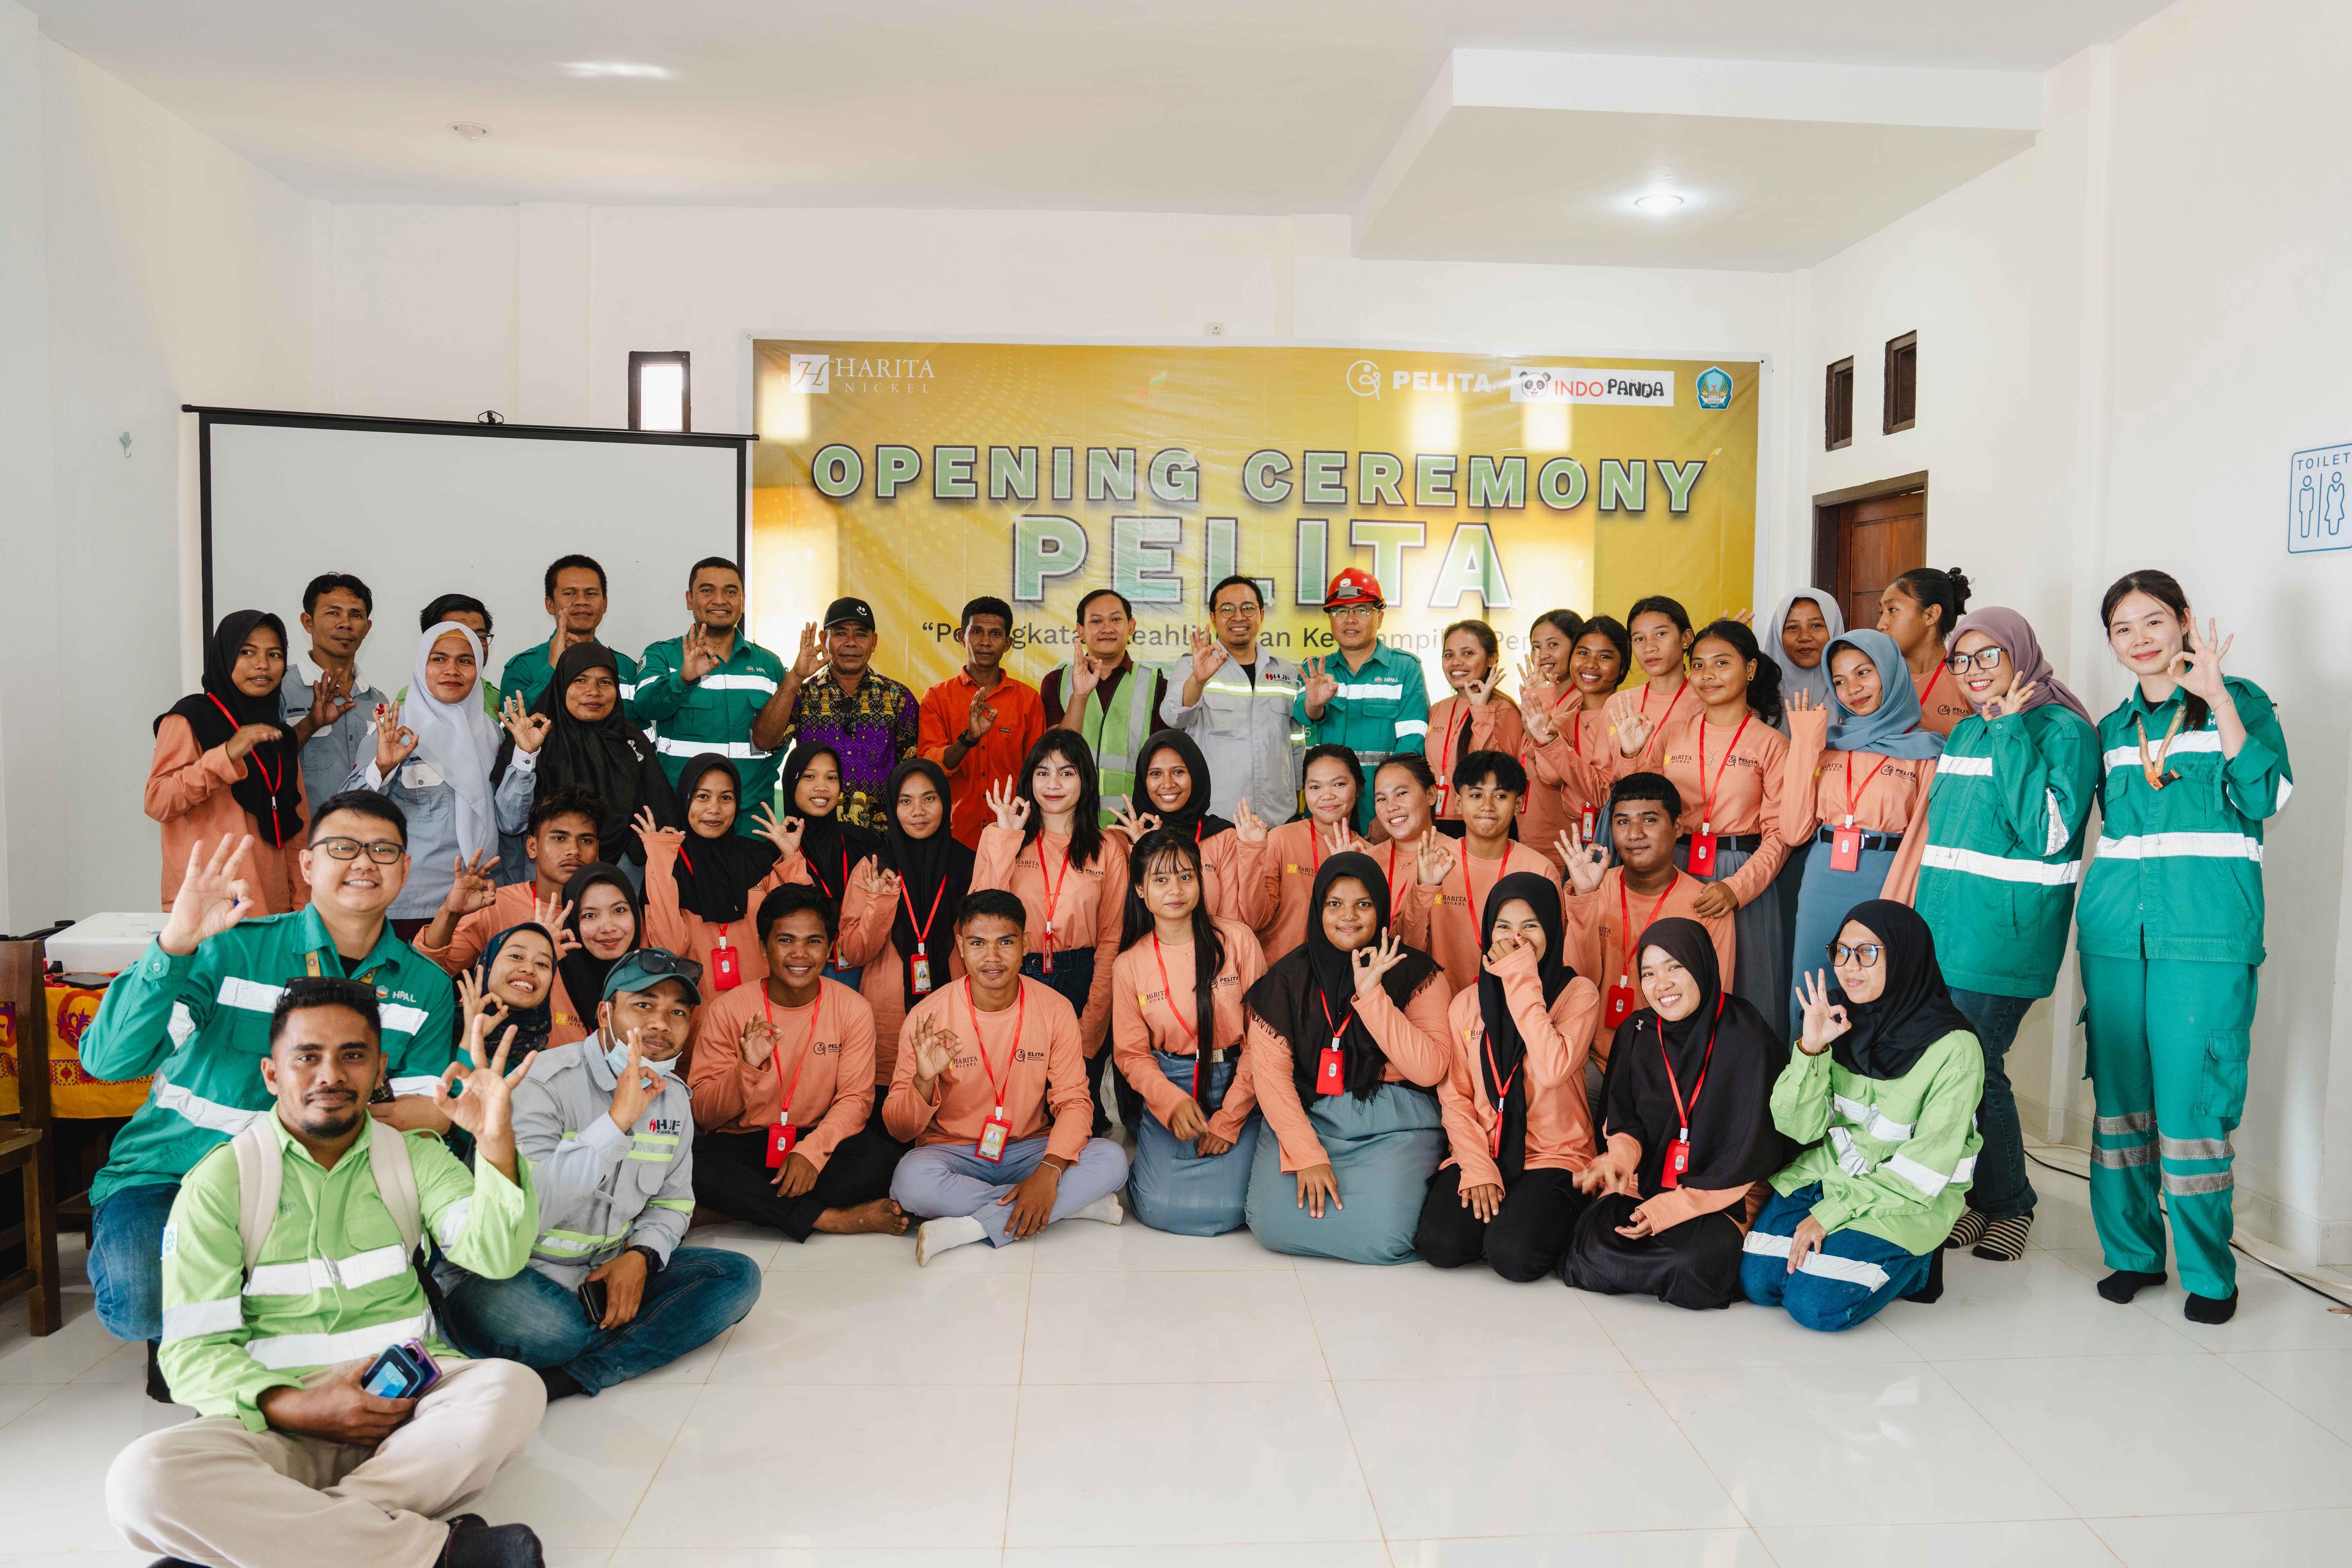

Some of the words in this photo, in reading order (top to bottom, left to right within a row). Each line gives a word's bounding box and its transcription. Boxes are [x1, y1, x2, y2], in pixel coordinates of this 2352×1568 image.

[834, 358, 935, 378] HARITA
[845, 383, 930, 394] NICKEL
[1393, 371, 1492, 393] PELITA
[1555, 380, 1604, 398] INDO
[1607, 378, 1664, 399] PANDA
[2297, 452, 2350, 471] TOILET
[812, 443, 1199, 503] OPENING
[1243, 449, 1708, 513] CEREMONY
[1012, 514, 1512, 609] PELITA
[1896, 768, 1916, 778] PELITA
[393, 990, 417, 1003] HPAL
[1147, 990, 1166, 1000] HARIT
[954, 1056, 978, 1065] HARITA
[657, 1119, 680, 1131] HJF
